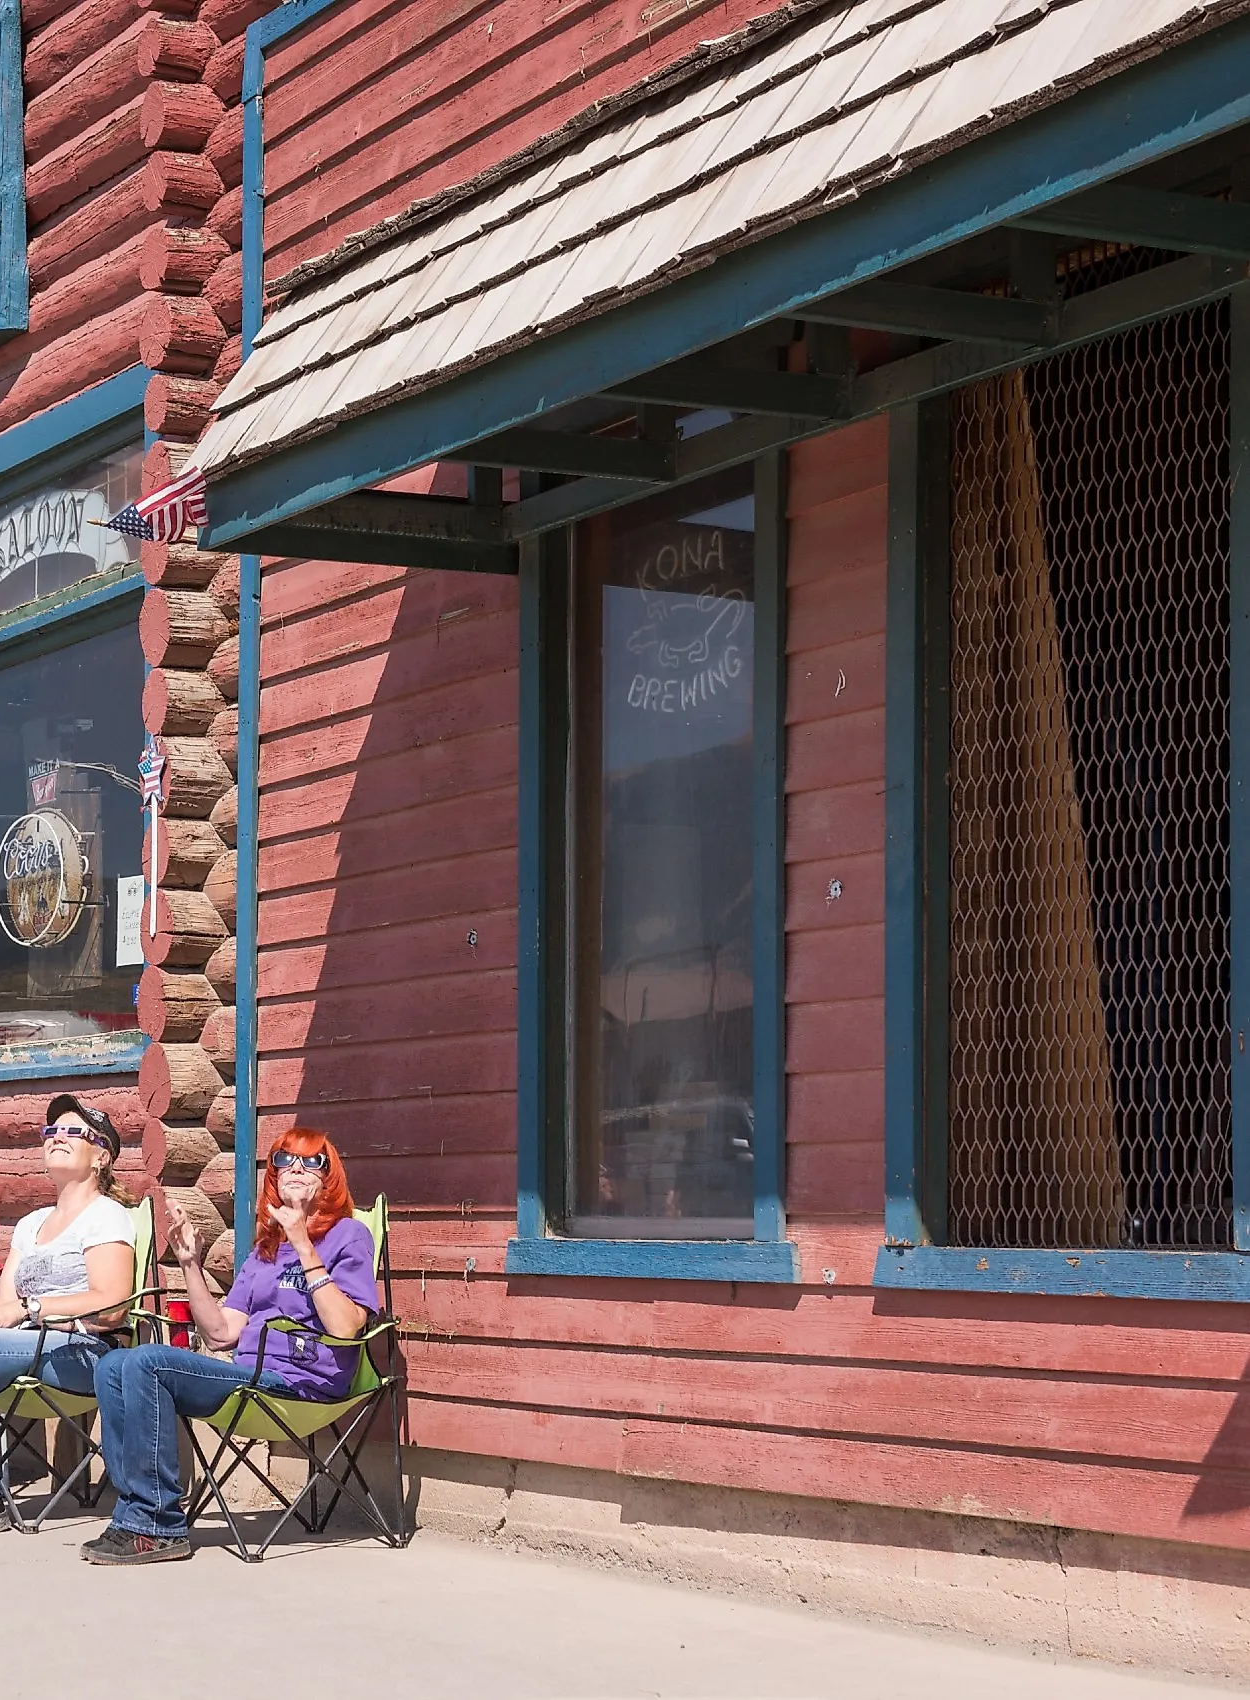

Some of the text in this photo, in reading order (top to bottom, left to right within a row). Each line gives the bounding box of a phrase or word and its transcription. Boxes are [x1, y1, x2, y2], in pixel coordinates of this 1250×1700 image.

[636, 530, 725, 602] KONA
[627, 645, 742, 713] BREWING
[28, 762, 46, 778] MAKE
[54, 757, 60, 769] A
